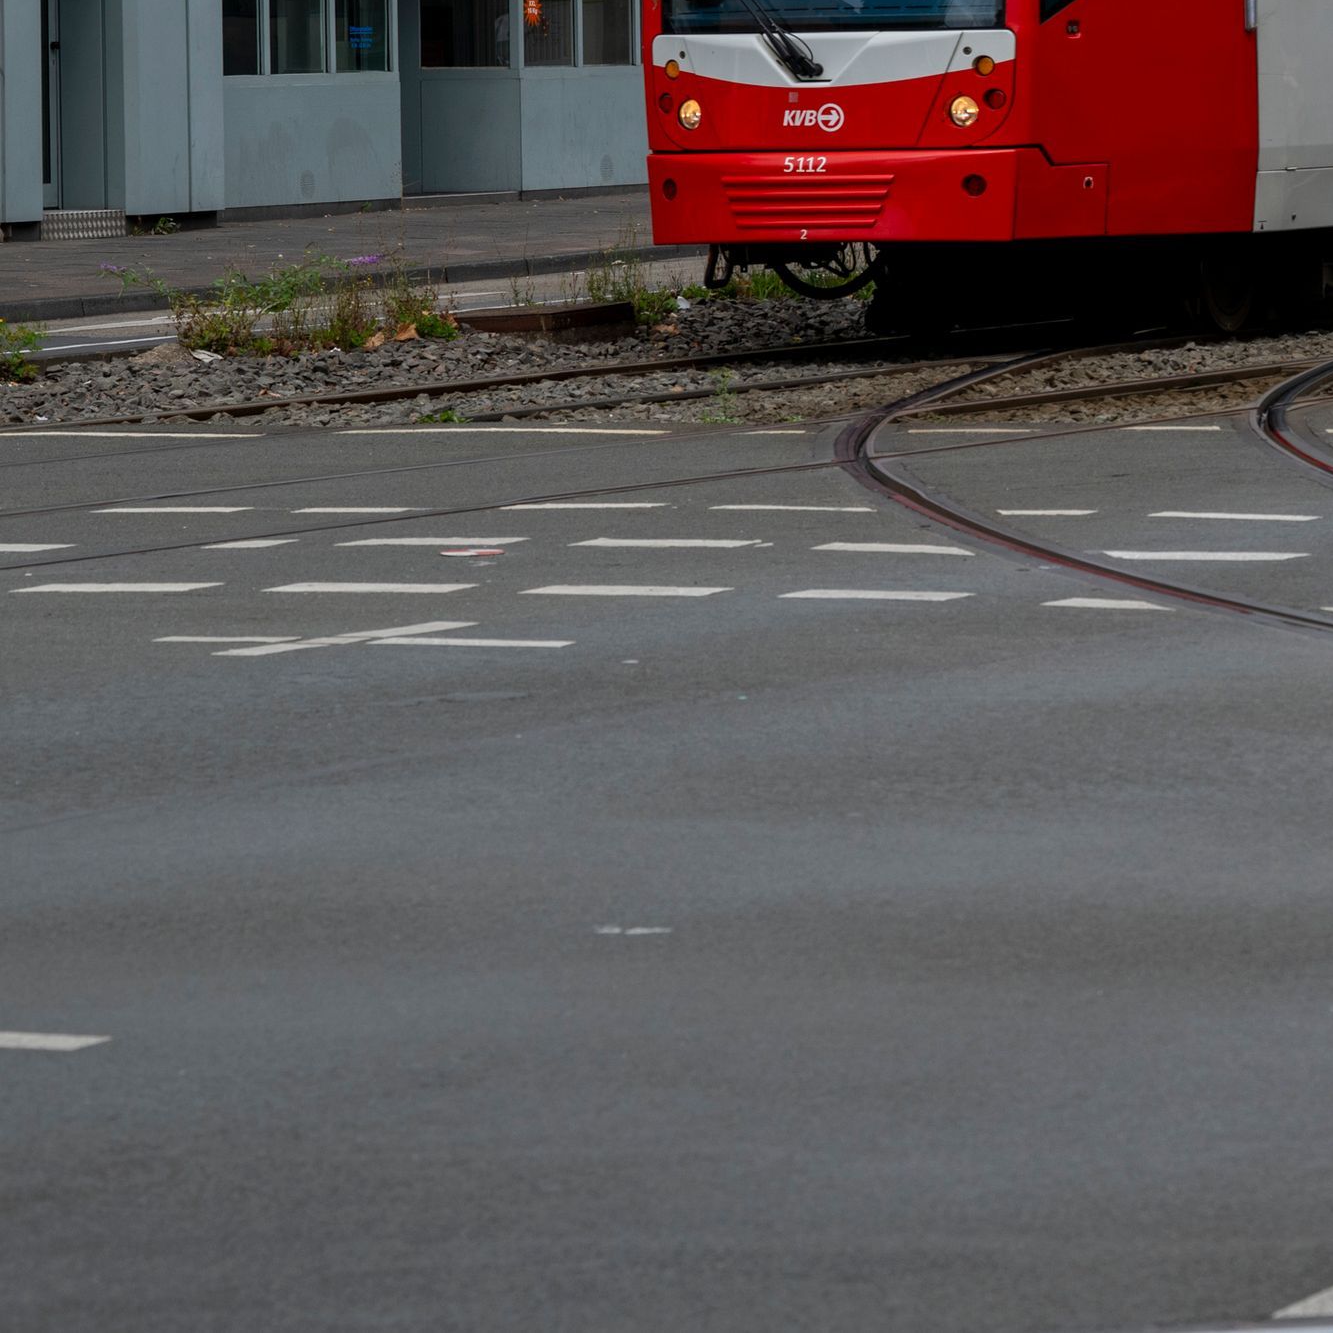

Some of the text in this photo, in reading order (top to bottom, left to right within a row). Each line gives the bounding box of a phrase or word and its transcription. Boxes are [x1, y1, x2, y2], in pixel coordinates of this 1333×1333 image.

[783, 109, 818, 127] KVB
[783, 156, 827, 173] 5112
[800, 229, 808, 241] 2
